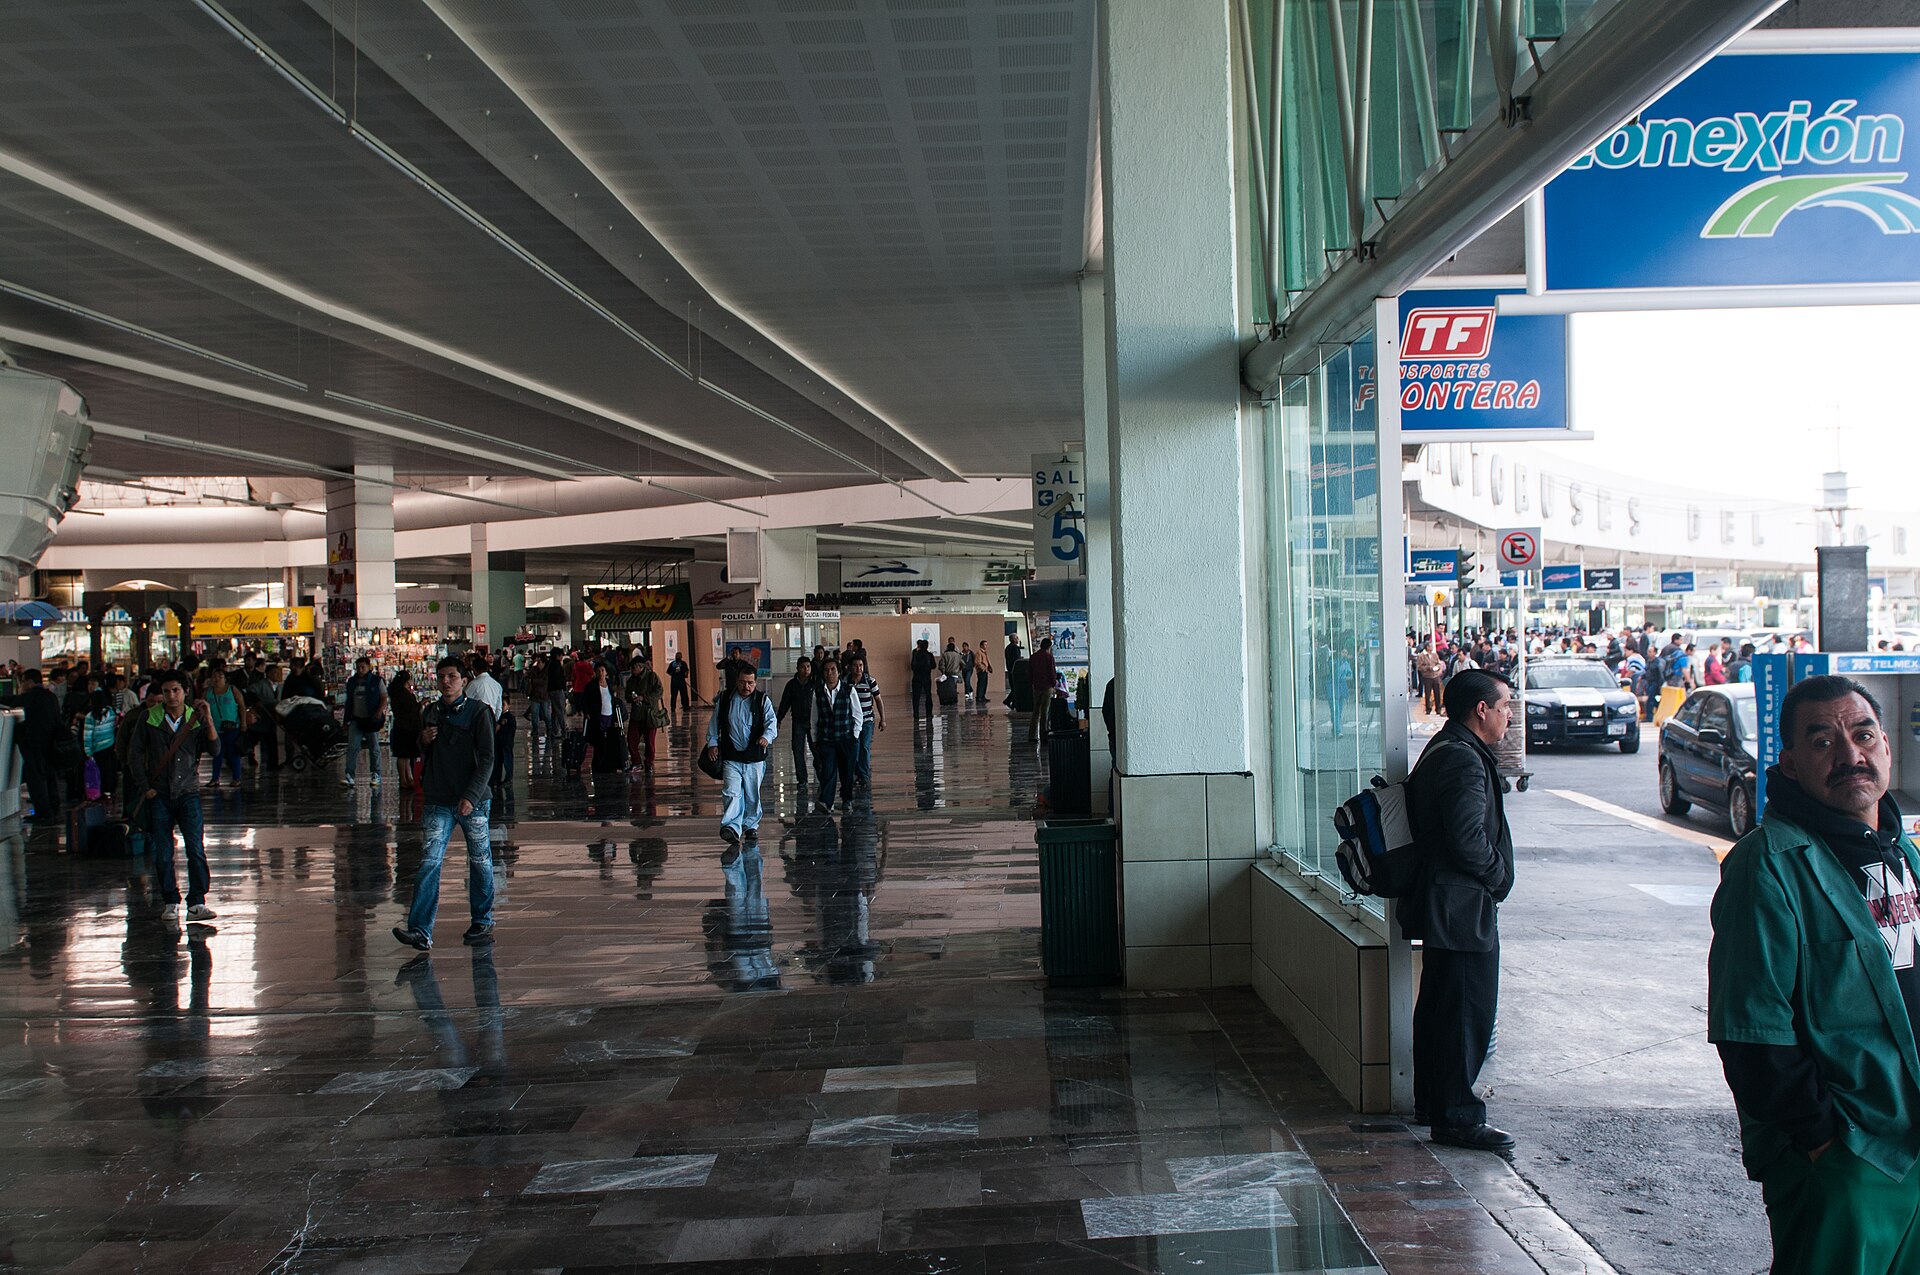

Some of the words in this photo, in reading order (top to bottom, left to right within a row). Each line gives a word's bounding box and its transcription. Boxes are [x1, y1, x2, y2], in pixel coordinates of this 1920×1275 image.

[1566, 99, 1905, 172] onexión
[1416, 316, 1485, 351] TF
[1355, 379, 1541, 410] FONTERA
[1051, 510, 1086, 561] 5
[220, 612, 269, 633] Manolo
[721, 612, 755, 621] POLICÍA
[766, 611, 803, 620] FEDERAL
[1873, 659, 1919, 669] TELMEX
